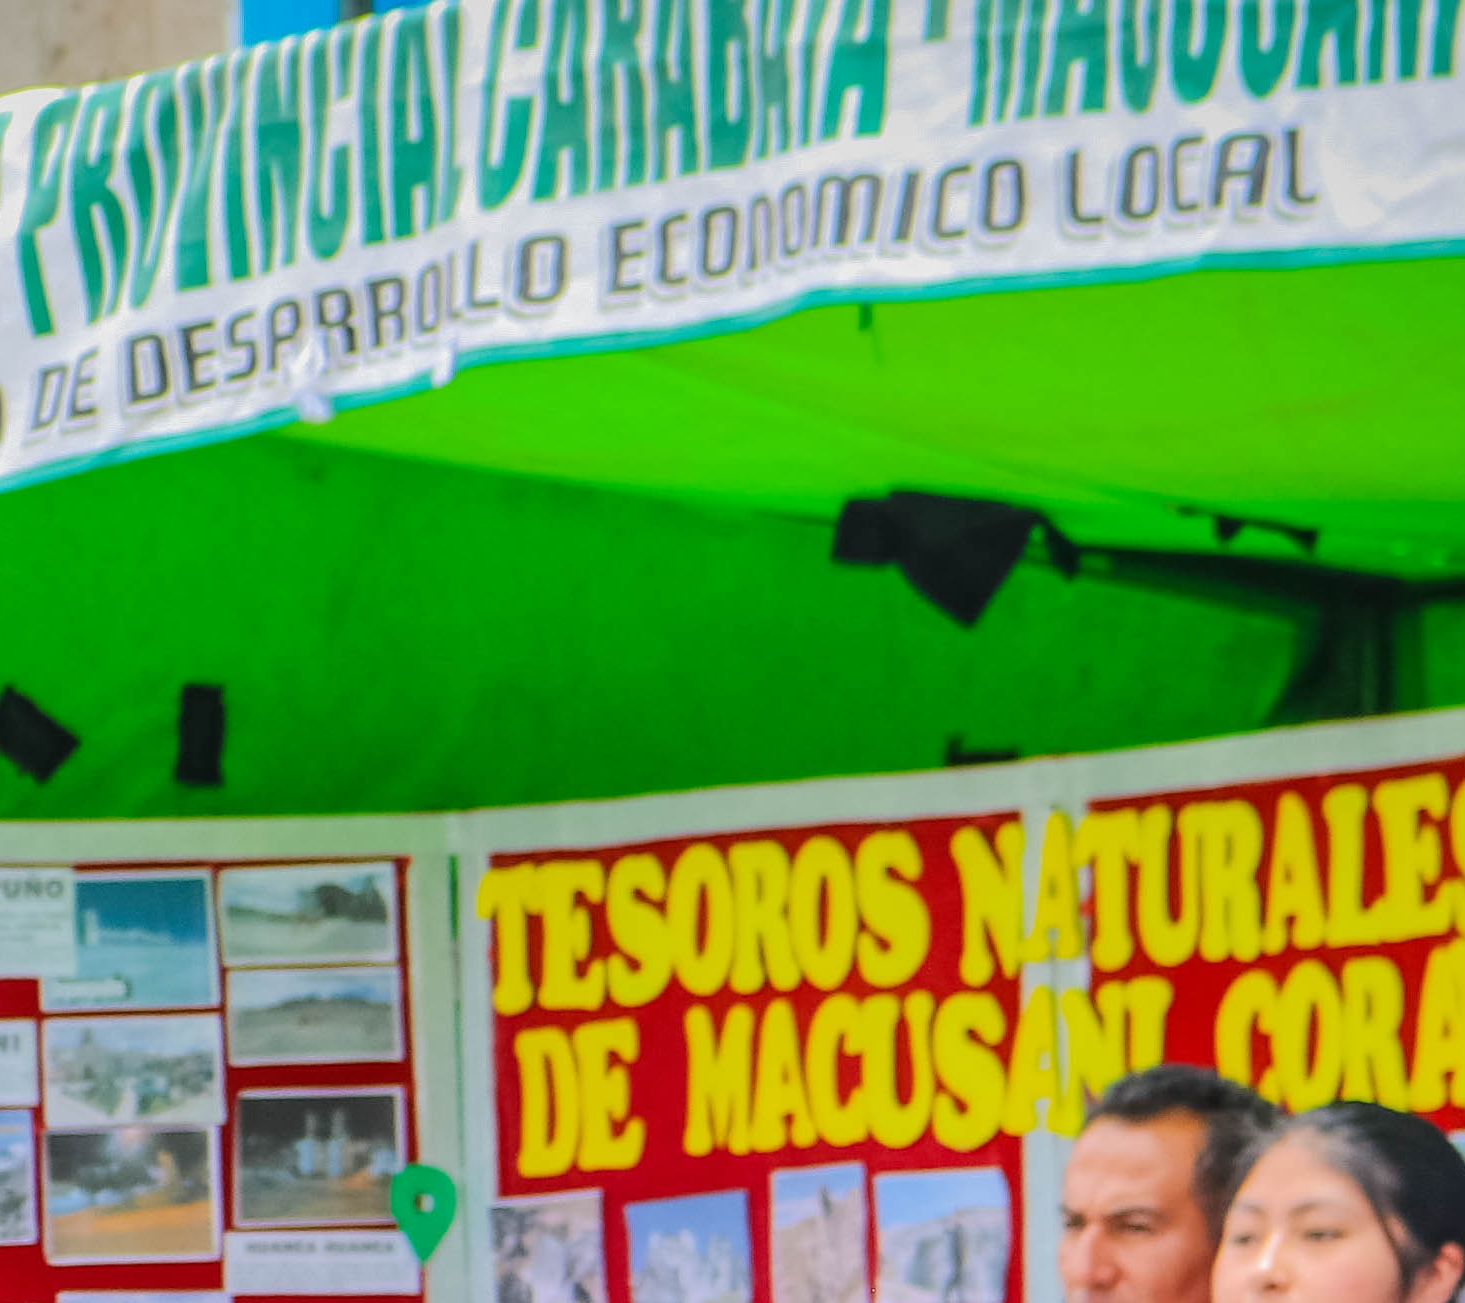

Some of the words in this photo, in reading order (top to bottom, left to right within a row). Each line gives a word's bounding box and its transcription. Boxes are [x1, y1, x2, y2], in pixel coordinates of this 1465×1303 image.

[17, 0, 469, 338] PROVINCIAL
[31, 346, 99, 431] DE
[129, 233, 568, 405] DESARROLLO
[612, 158, 1028, 293] ECONOMICO
[1068, 126, 1318, 226] LOCAL
[477, 830, 932, 1016] TESOROS
[514, 1017, 646, 1178] DE
[682, 974, 1173, 1156] MACUSANI
